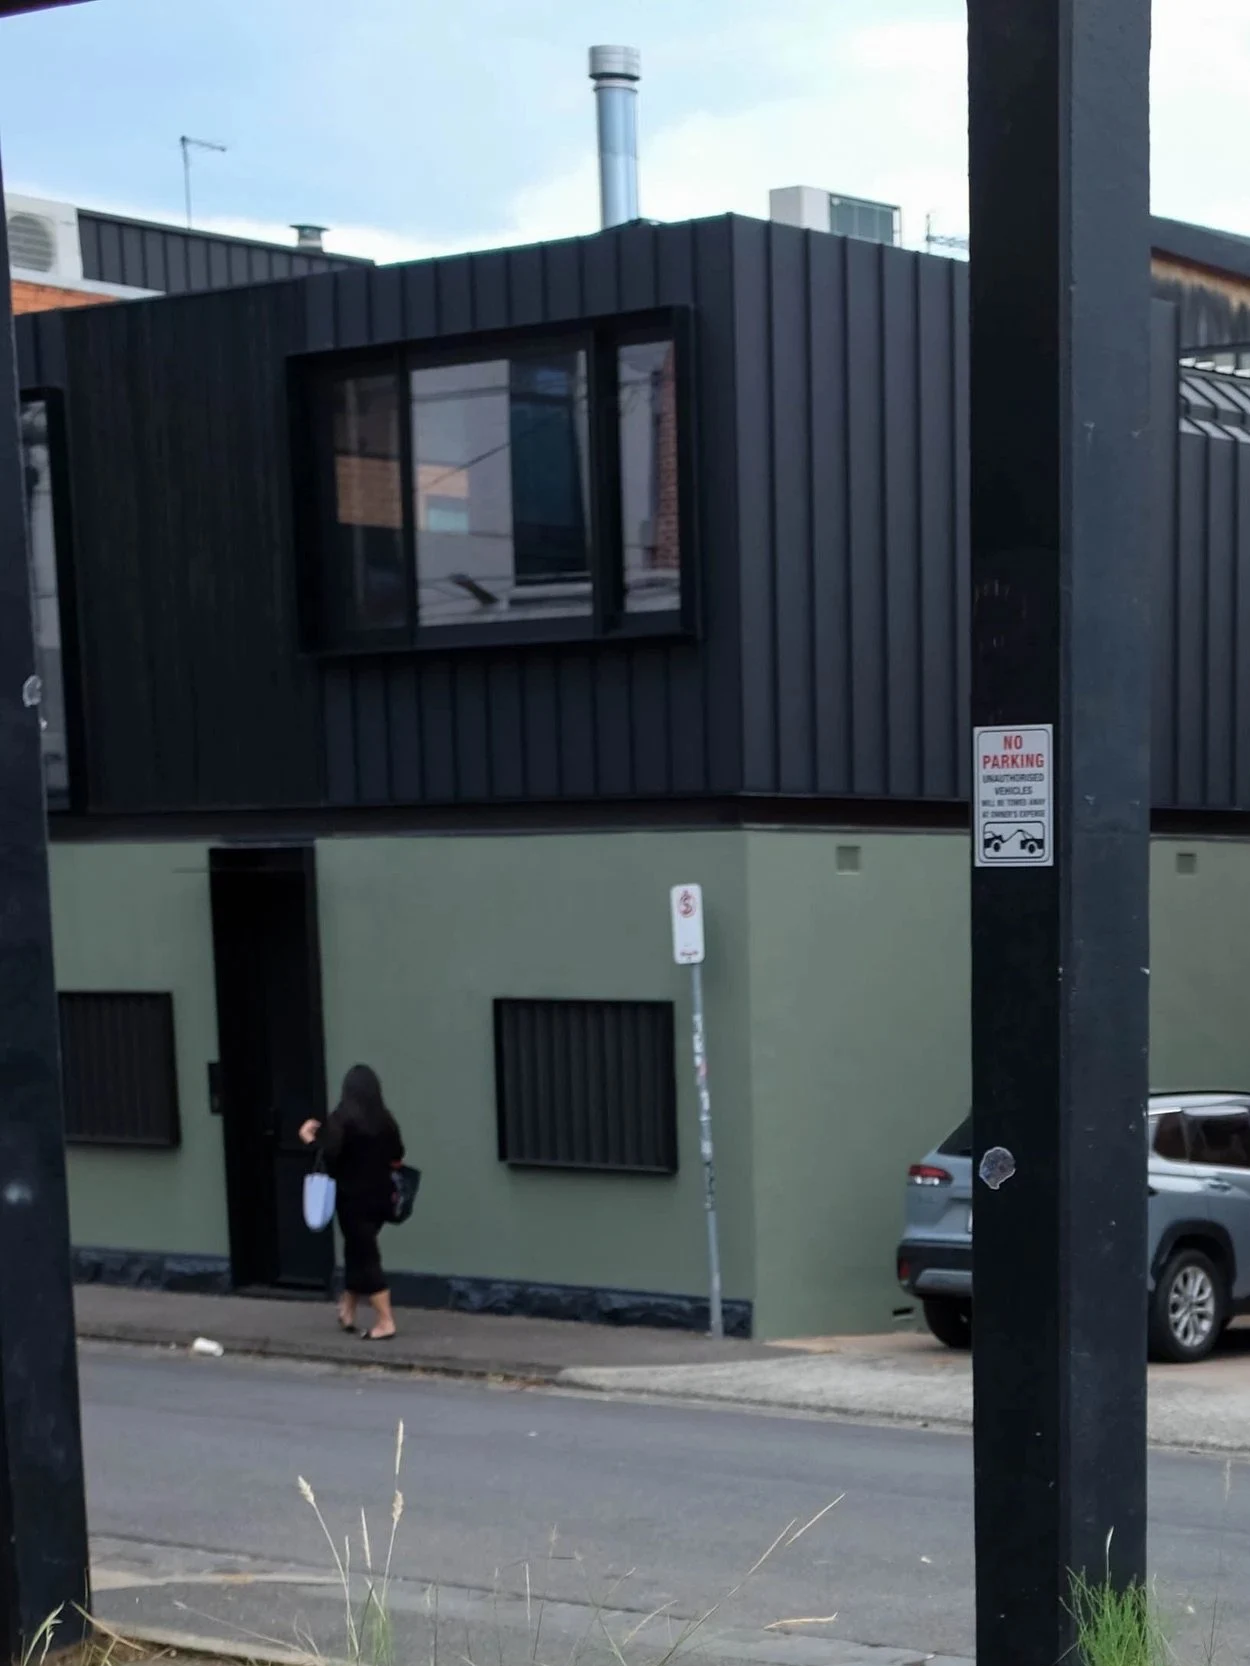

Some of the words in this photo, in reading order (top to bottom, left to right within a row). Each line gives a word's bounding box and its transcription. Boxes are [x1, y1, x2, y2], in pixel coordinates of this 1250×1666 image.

[1003, 735, 1023, 750] NO
[982, 753, 1045, 769] PARKING
[982, 773, 1045, 783] UNAUTHORISED
[995, 786, 1033, 796] VEHICLES
